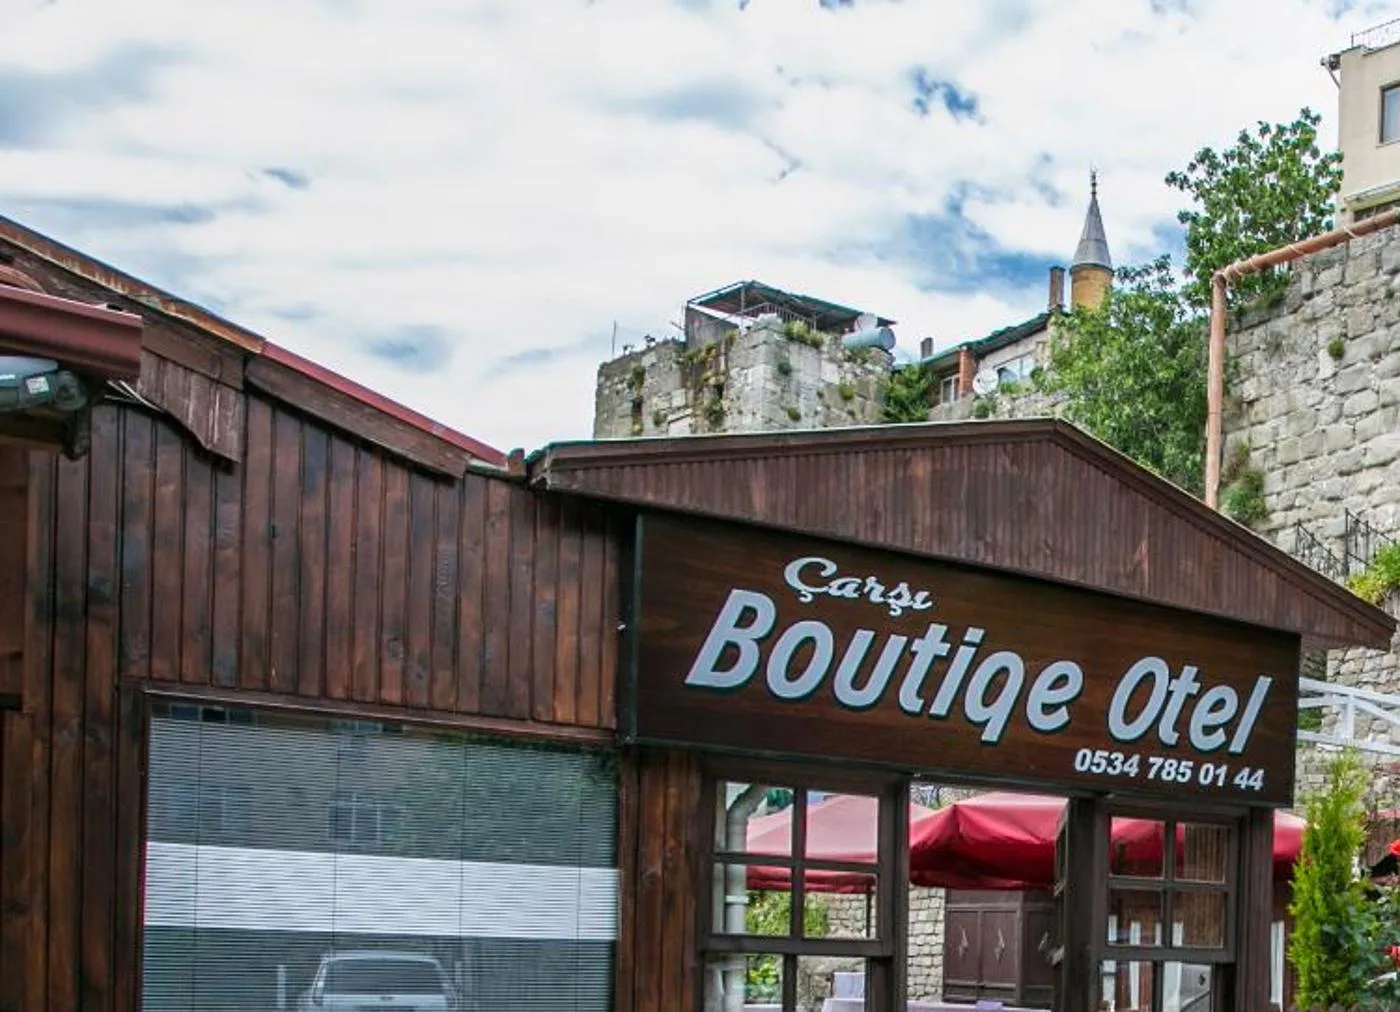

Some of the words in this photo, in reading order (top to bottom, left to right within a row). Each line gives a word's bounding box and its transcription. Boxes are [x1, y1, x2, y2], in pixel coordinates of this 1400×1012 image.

[684, 588, 1086, 744] Boutiqe
[1108, 656, 1273, 754] Otel
[1074, 748, 1141, 778] 0534
[1147, 756, 1194, 784] 785
[1199, 763, 1228, 787] 01
[1233, 767, 1265, 792] 44
